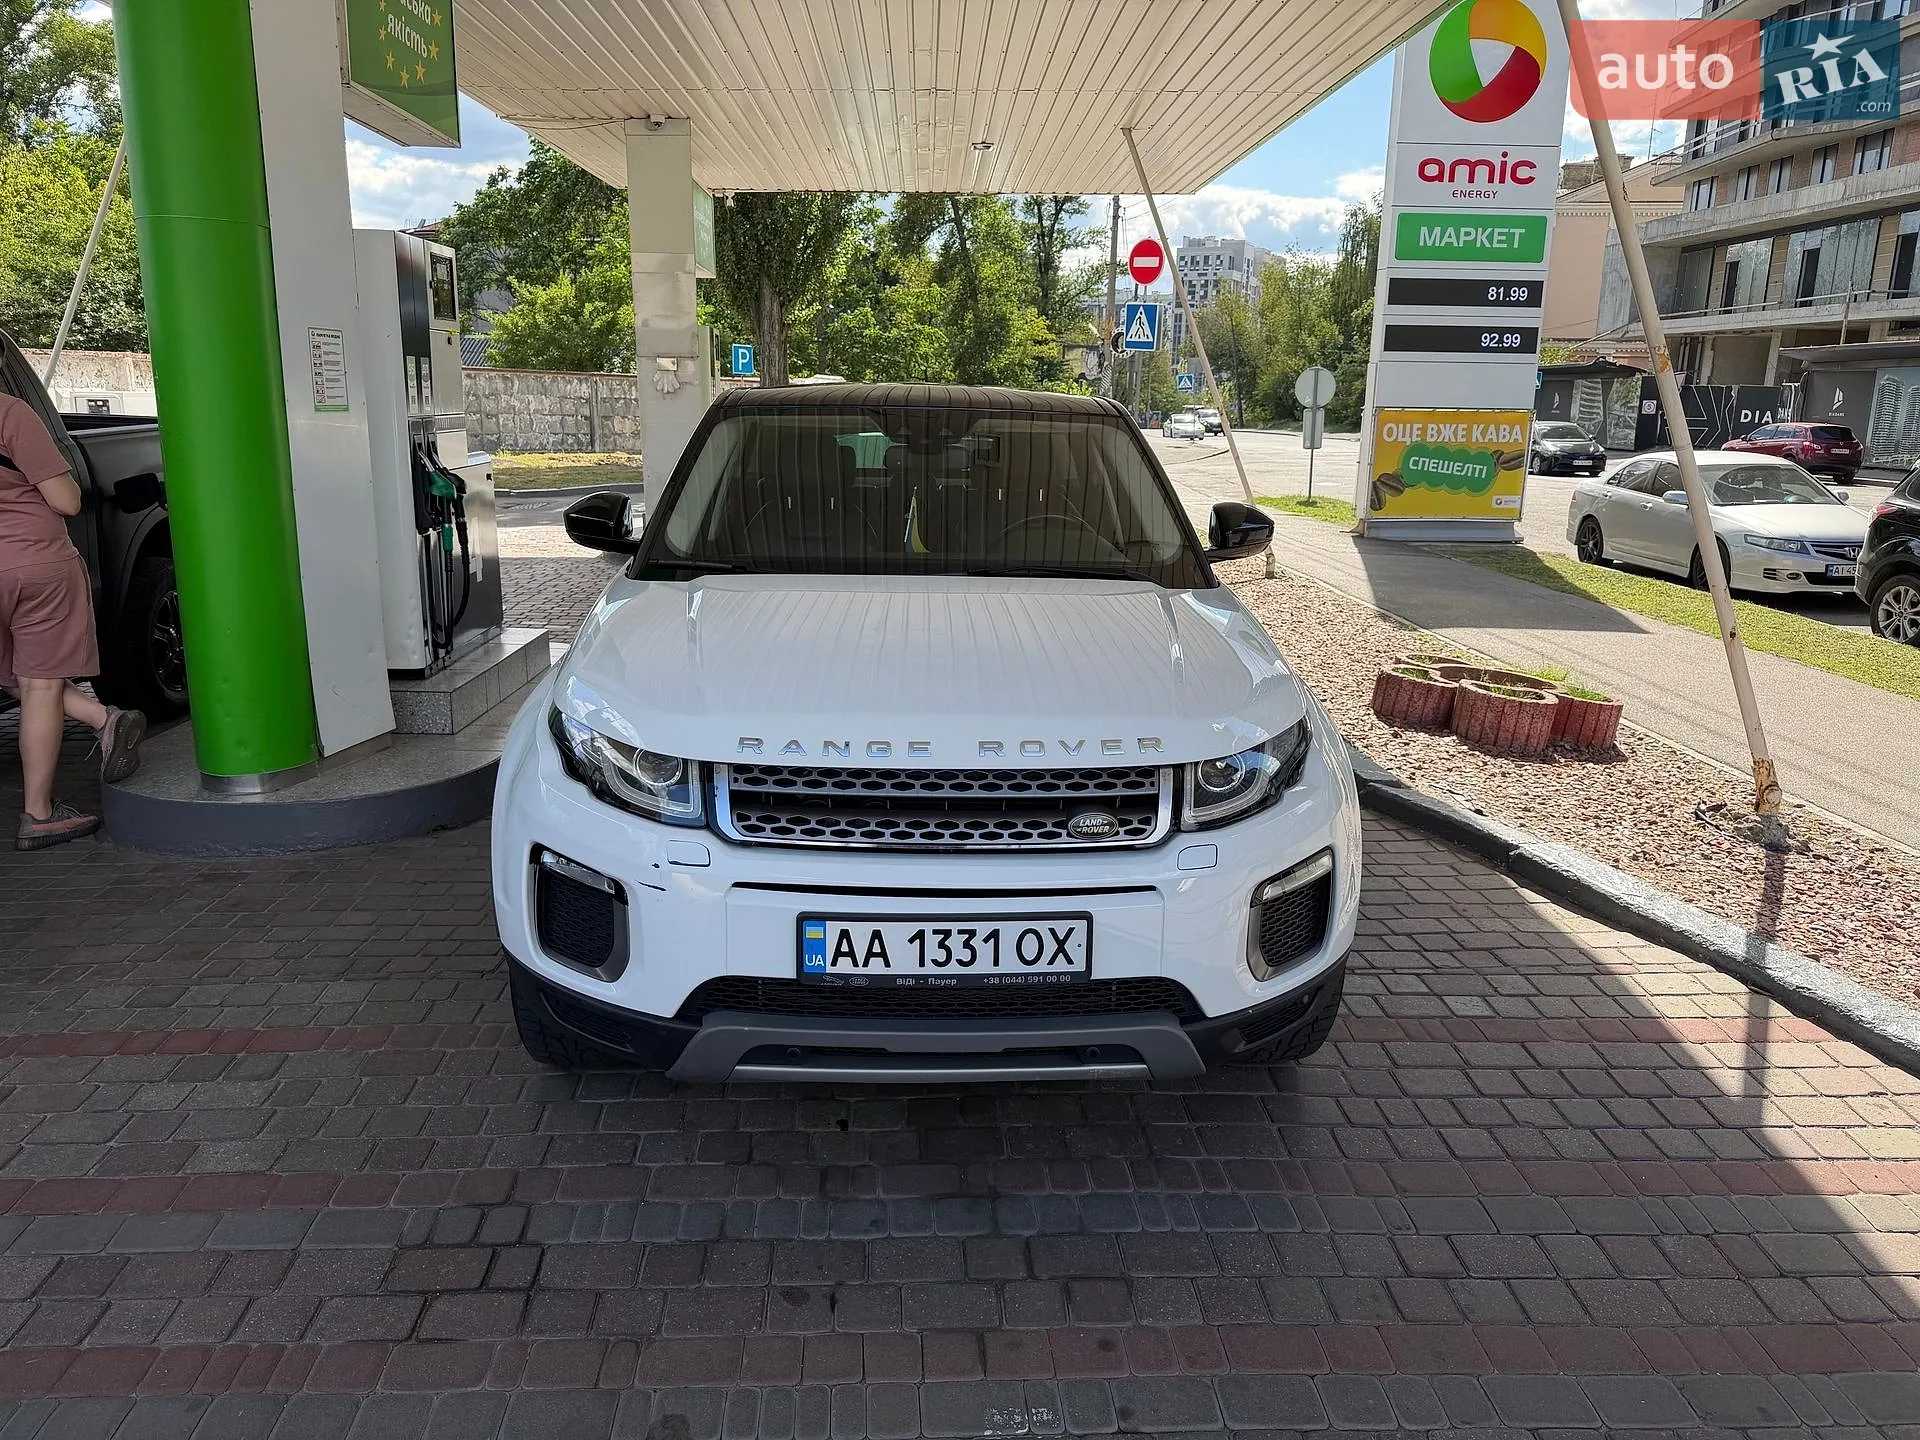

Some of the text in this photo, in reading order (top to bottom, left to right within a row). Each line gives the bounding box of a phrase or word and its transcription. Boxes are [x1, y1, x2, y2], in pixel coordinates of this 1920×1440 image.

[387, 13, 428, 58] якість
[1417, 151, 1537, 185] amic
[1452, 189, 1498, 199] ENERGY
[1419, 226, 1526, 249] МАРКЕТ
[1487, 286, 1528, 301] 81.99
[1480, 333, 1521, 347] 92.99
[738, 348, 749, 371] P
[1740, 409, 1773, 424] DIA
[1382, 423, 1523, 445] ОЦЕ ВЖЕ КАВА
[1408, 456, 1487, 479] СПЕШЕЛТІ
[737, 736, 1164, 758] RANGE ROVER
[1080, 819, 1103, 827] LAND
[1081, 826, 1109, 834] ROVER
[830, 926, 1077, 968] AA 1331 OX
[805, 954, 825, 967] UA
[928, 977, 957, 987] Пауер
[983, 974, 1071, 985] +38 (044) 591 00 00
